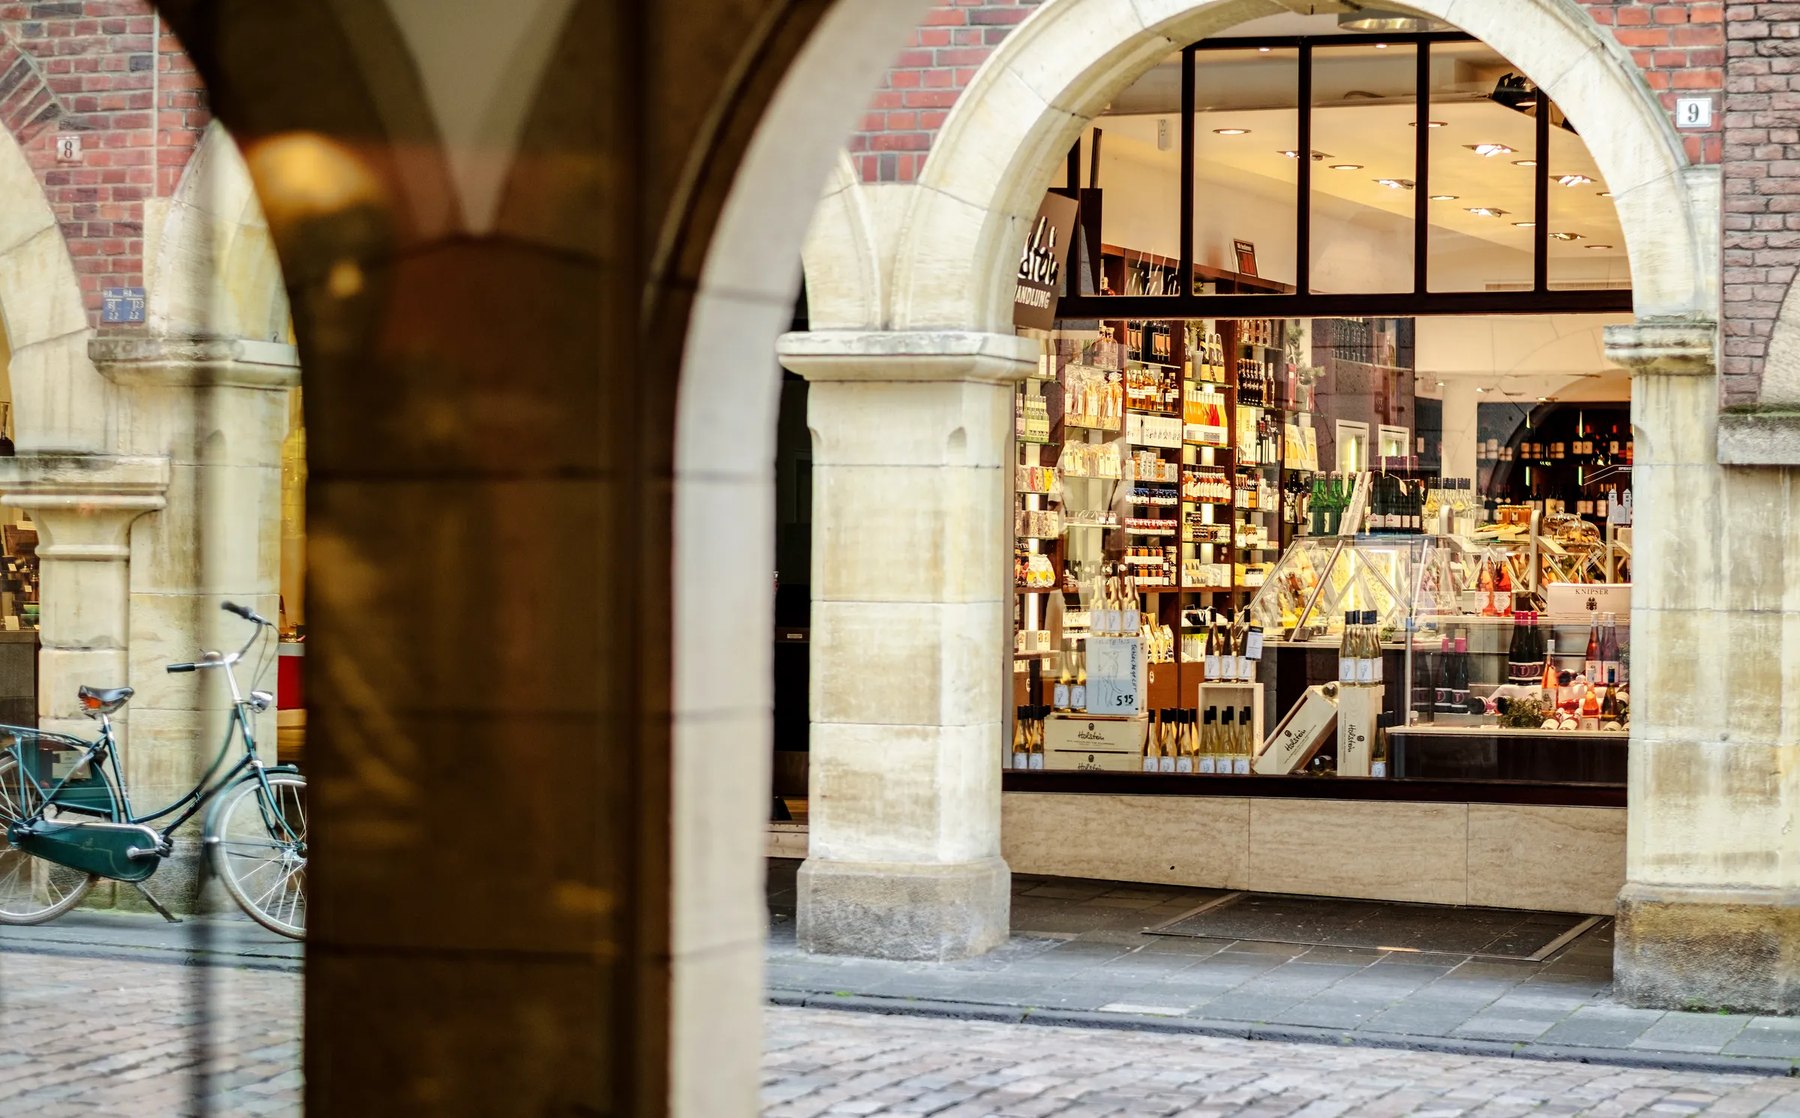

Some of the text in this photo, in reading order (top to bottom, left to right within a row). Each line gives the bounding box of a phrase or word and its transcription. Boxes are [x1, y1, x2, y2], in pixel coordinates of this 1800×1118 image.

[1687, 102, 1699, 123] 9
[64, 140, 73, 159] 8
[1077, 730, 1105, 741] Holstein
